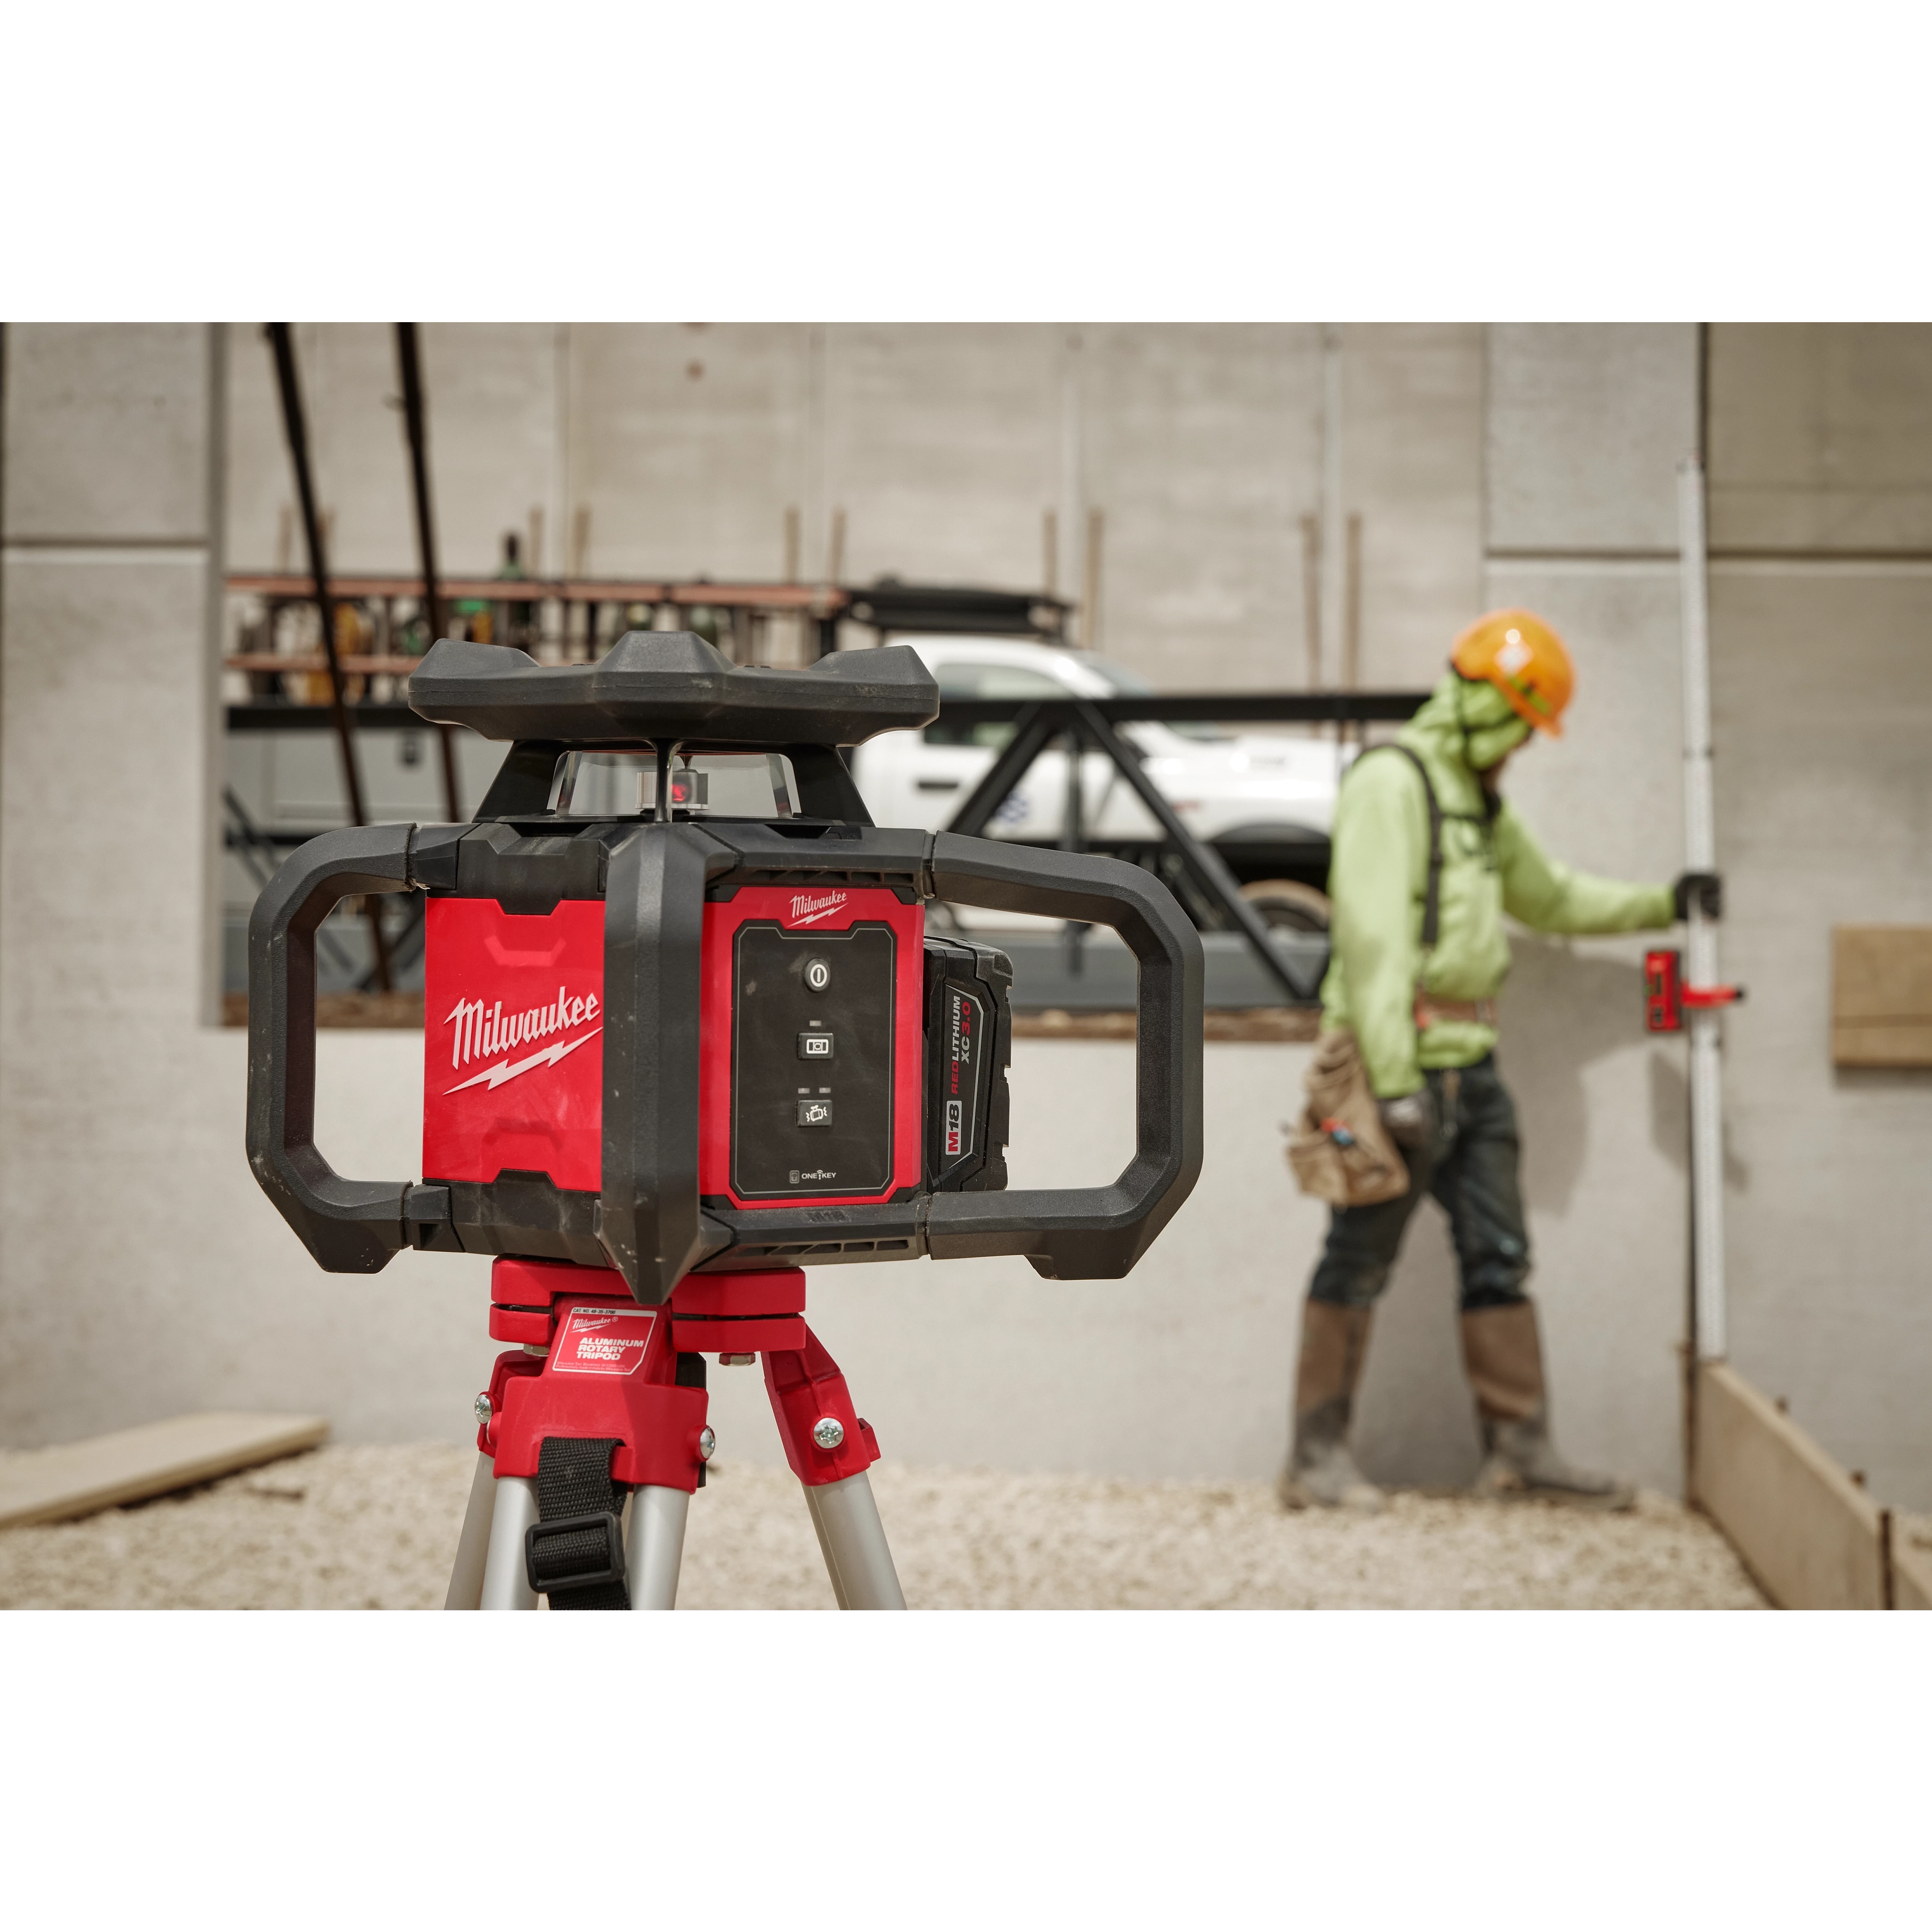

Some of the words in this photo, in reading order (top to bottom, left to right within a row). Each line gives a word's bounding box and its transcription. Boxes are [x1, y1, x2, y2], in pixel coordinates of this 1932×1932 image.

[789, 890, 847, 918] Milwaukee
[443, 986, 600, 1070] Milwaukee
[951, 995, 960, 1094] REDLITHIUM
[948, 1104, 960, 1152] M18
[577, 1351, 621, 1360] TRIPOD
[578, 1344, 626, 1353] ROTARY
[580, 1337, 644, 1347] ALUMINUM
